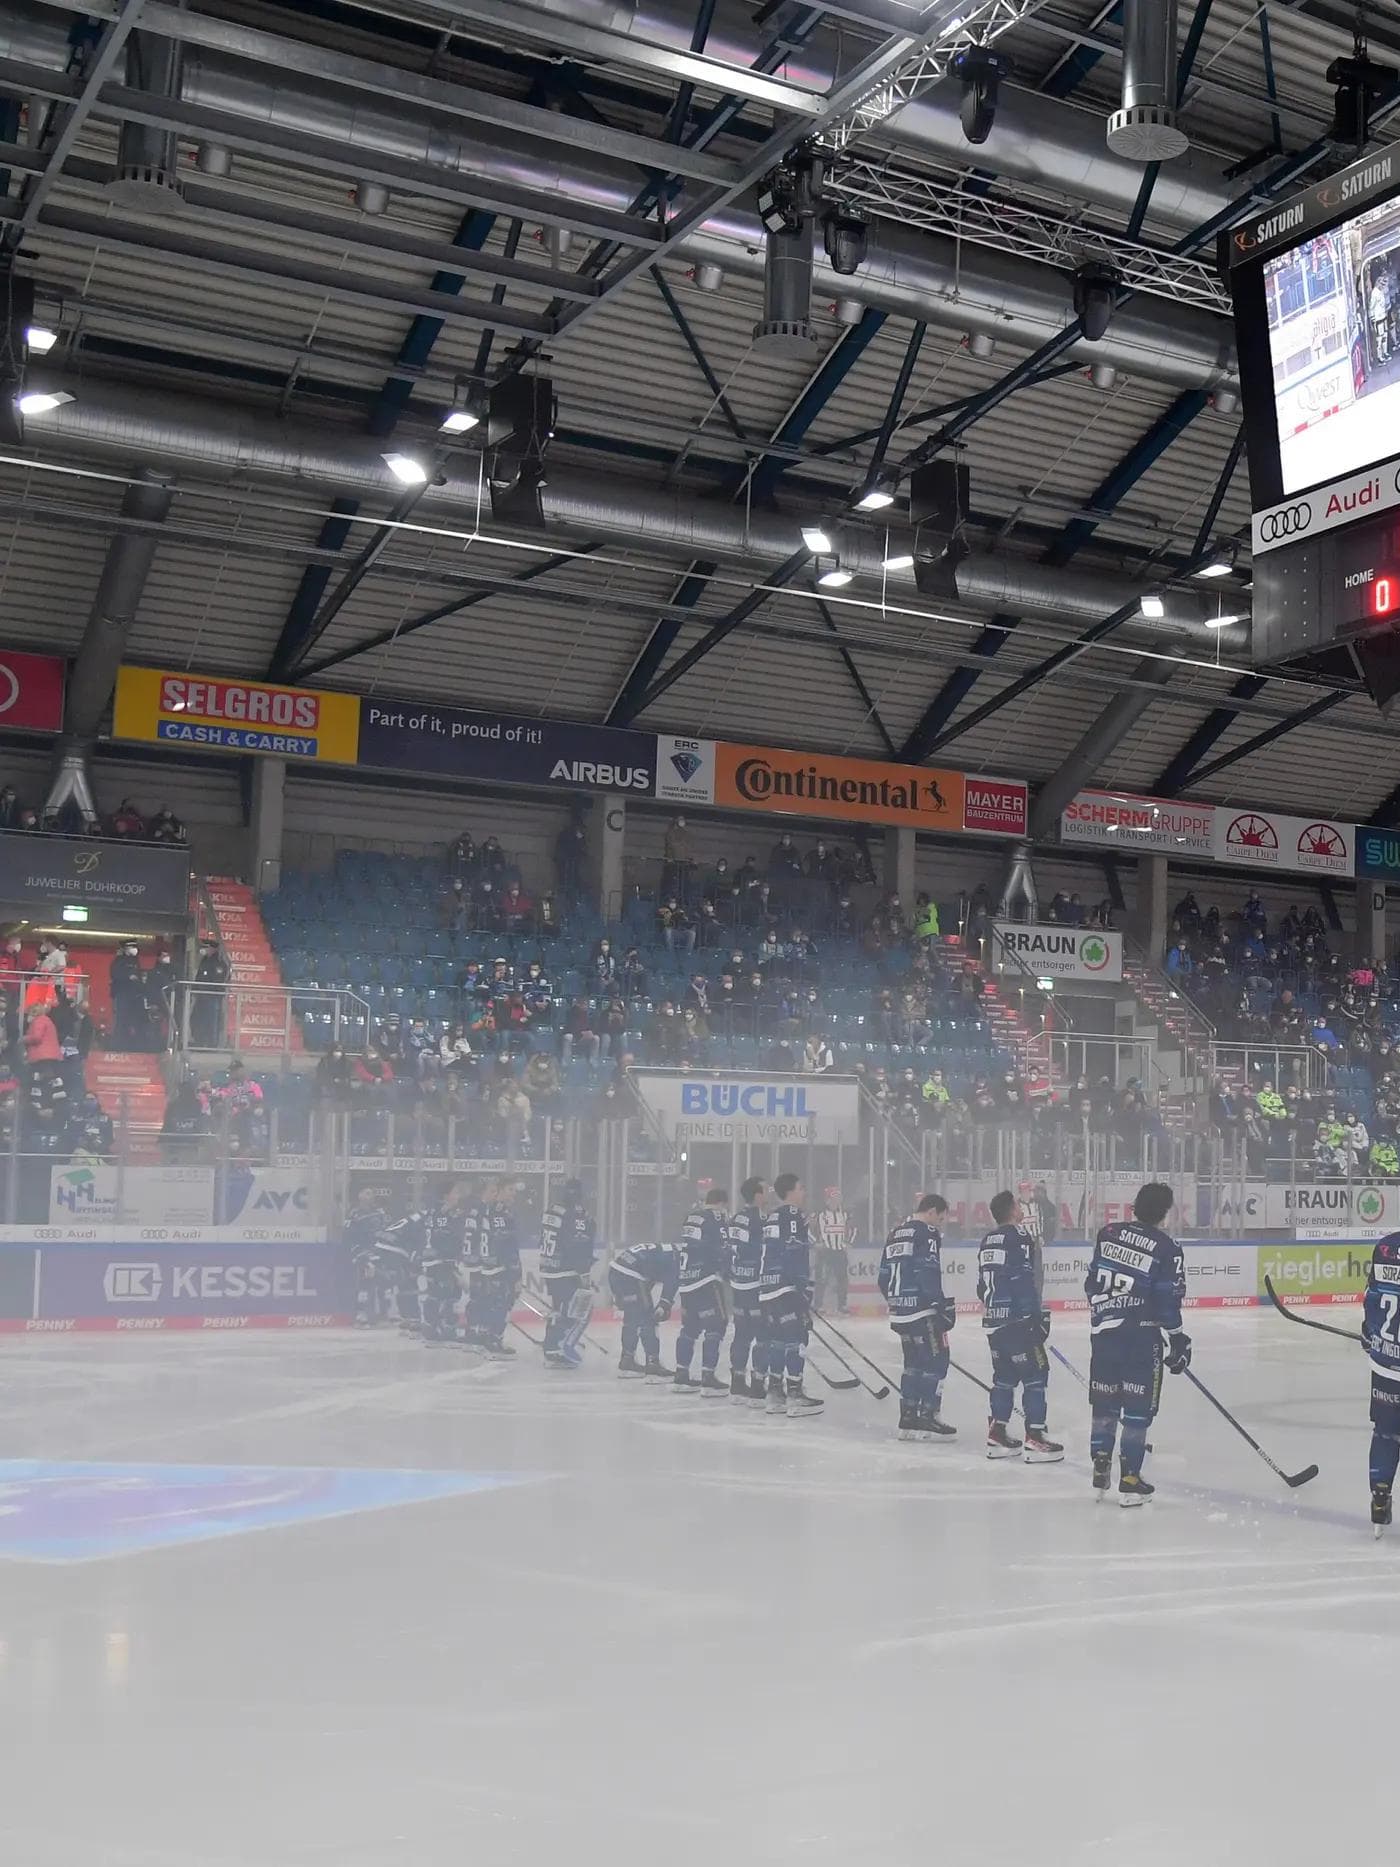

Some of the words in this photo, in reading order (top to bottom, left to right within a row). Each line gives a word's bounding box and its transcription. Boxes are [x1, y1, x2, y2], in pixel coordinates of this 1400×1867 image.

[1341, 157, 1392, 201] SATURN
[1256, 203, 1304, 245] SATURN
[1325, 479, 1380, 518] Audi
[1344, 567, 1375, 589] HOME
[1374, 579, 1390, 613] 0
[162, 679, 317, 729] SELGROS
[165, 723, 222, 745] CASH
[227, 728, 240, 746] &
[244, 732, 314, 755] CARRY
[369, 709, 405, 729] Part
[409, 715, 428, 730] of
[430, 716, 447, 734] it,
[451, 722, 501, 743] proud
[505, 726, 523, 743] of
[526, 729, 543, 745] it!
[674, 740, 699, 750] ERC
[549, 758, 650, 790] AIRBUS
[734, 758, 920, 811] Continental
[966, 789, 1025, 813] MAYER
[966, 808, 1025, 826] BAUZENTRUM
[1064, 822, 1107, 839] LOGISTIK
[1110, 828, 1169, 845] TRANSPORT
[1173, 836, 1211, 850] SERVICE
[25, 876, 81, 890] JUWELIER
[1004, 932, 1076, 955] BRAUN
[1031, 959, 1076, 972] entsorgen
[681, 1082, 817, 1118] BÜCHL
[1284, 1189, 1353, 1210] BRAUN
[67, 1228, 97, 1240] Audi
[172, 1228, 201, 1240] Audi
[1119, 1229, 1158, 1252] SATURN
[172, 1265, 317, 1299] KESSEL
